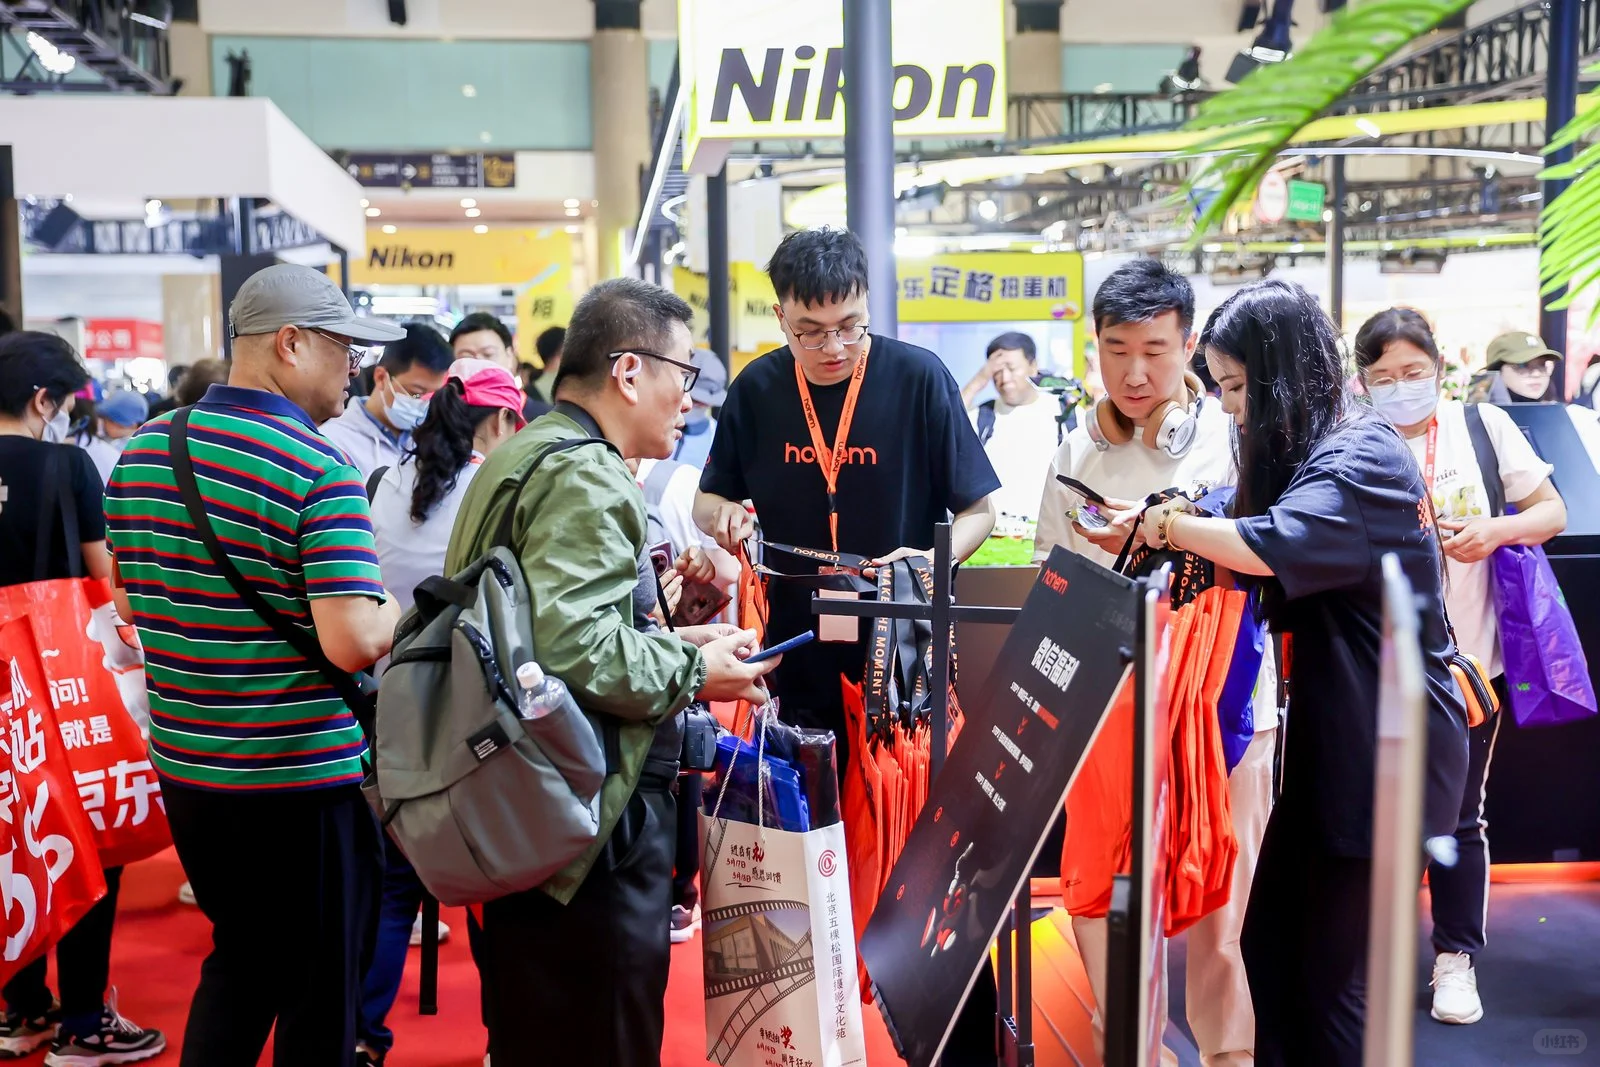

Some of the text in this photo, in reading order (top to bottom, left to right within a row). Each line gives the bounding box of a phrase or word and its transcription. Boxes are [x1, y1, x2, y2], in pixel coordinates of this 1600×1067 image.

[368, 246, 456, 269] Nikon
[896, 265, 1067, 303] 乐定格扭蛋机
[803, 398, 816, 429] hohem
[784, 442, 878, 466] hom
[832, 441, 844, 472] hohem
[793, 546, 840, 562] hohem
[880, 568, 894, 602] MAKE
[870, 636, 888, 696] MOMENT
[1030, 636, 1081, 693] 微信福利
[59, 714, 113, 751] 就是
